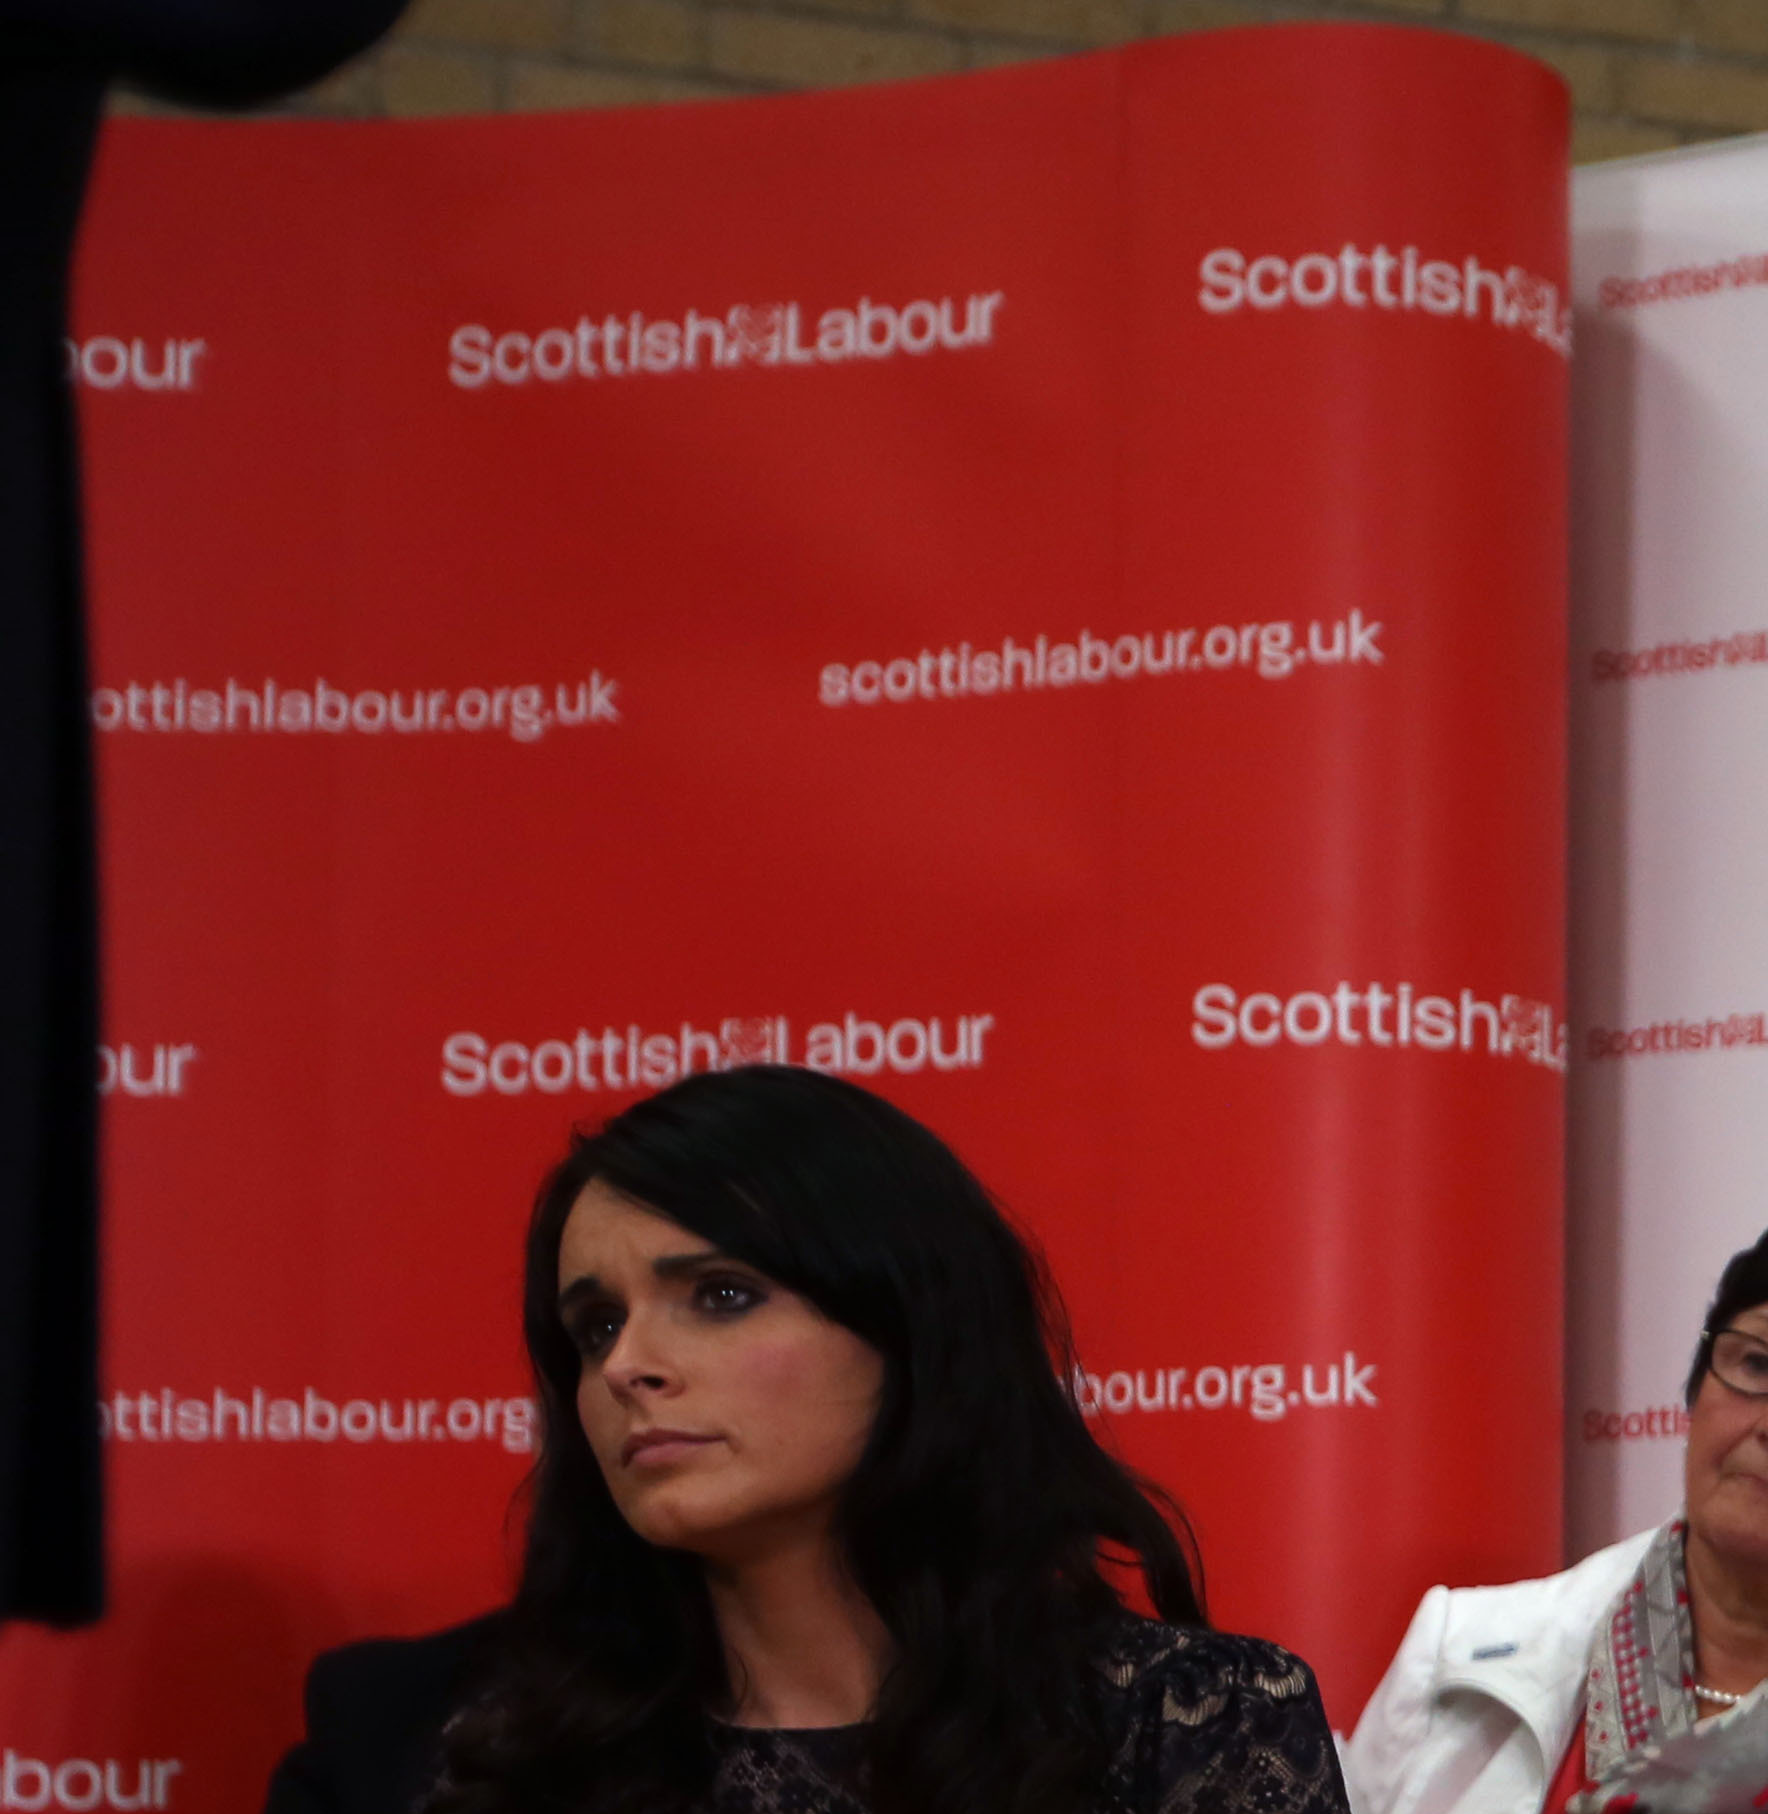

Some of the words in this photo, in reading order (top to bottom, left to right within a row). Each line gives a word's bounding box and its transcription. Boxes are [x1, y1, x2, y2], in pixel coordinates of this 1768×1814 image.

[448, 309, 725, 389] Scottish
[785, 291, 1003, 366] Labour
[818, 609, 1382, 707] scottishlabour.org.uk
[91, 674, 619, 742] ottishlabour.org.uk
[1190, 980, 1499, 1056] Scottish
